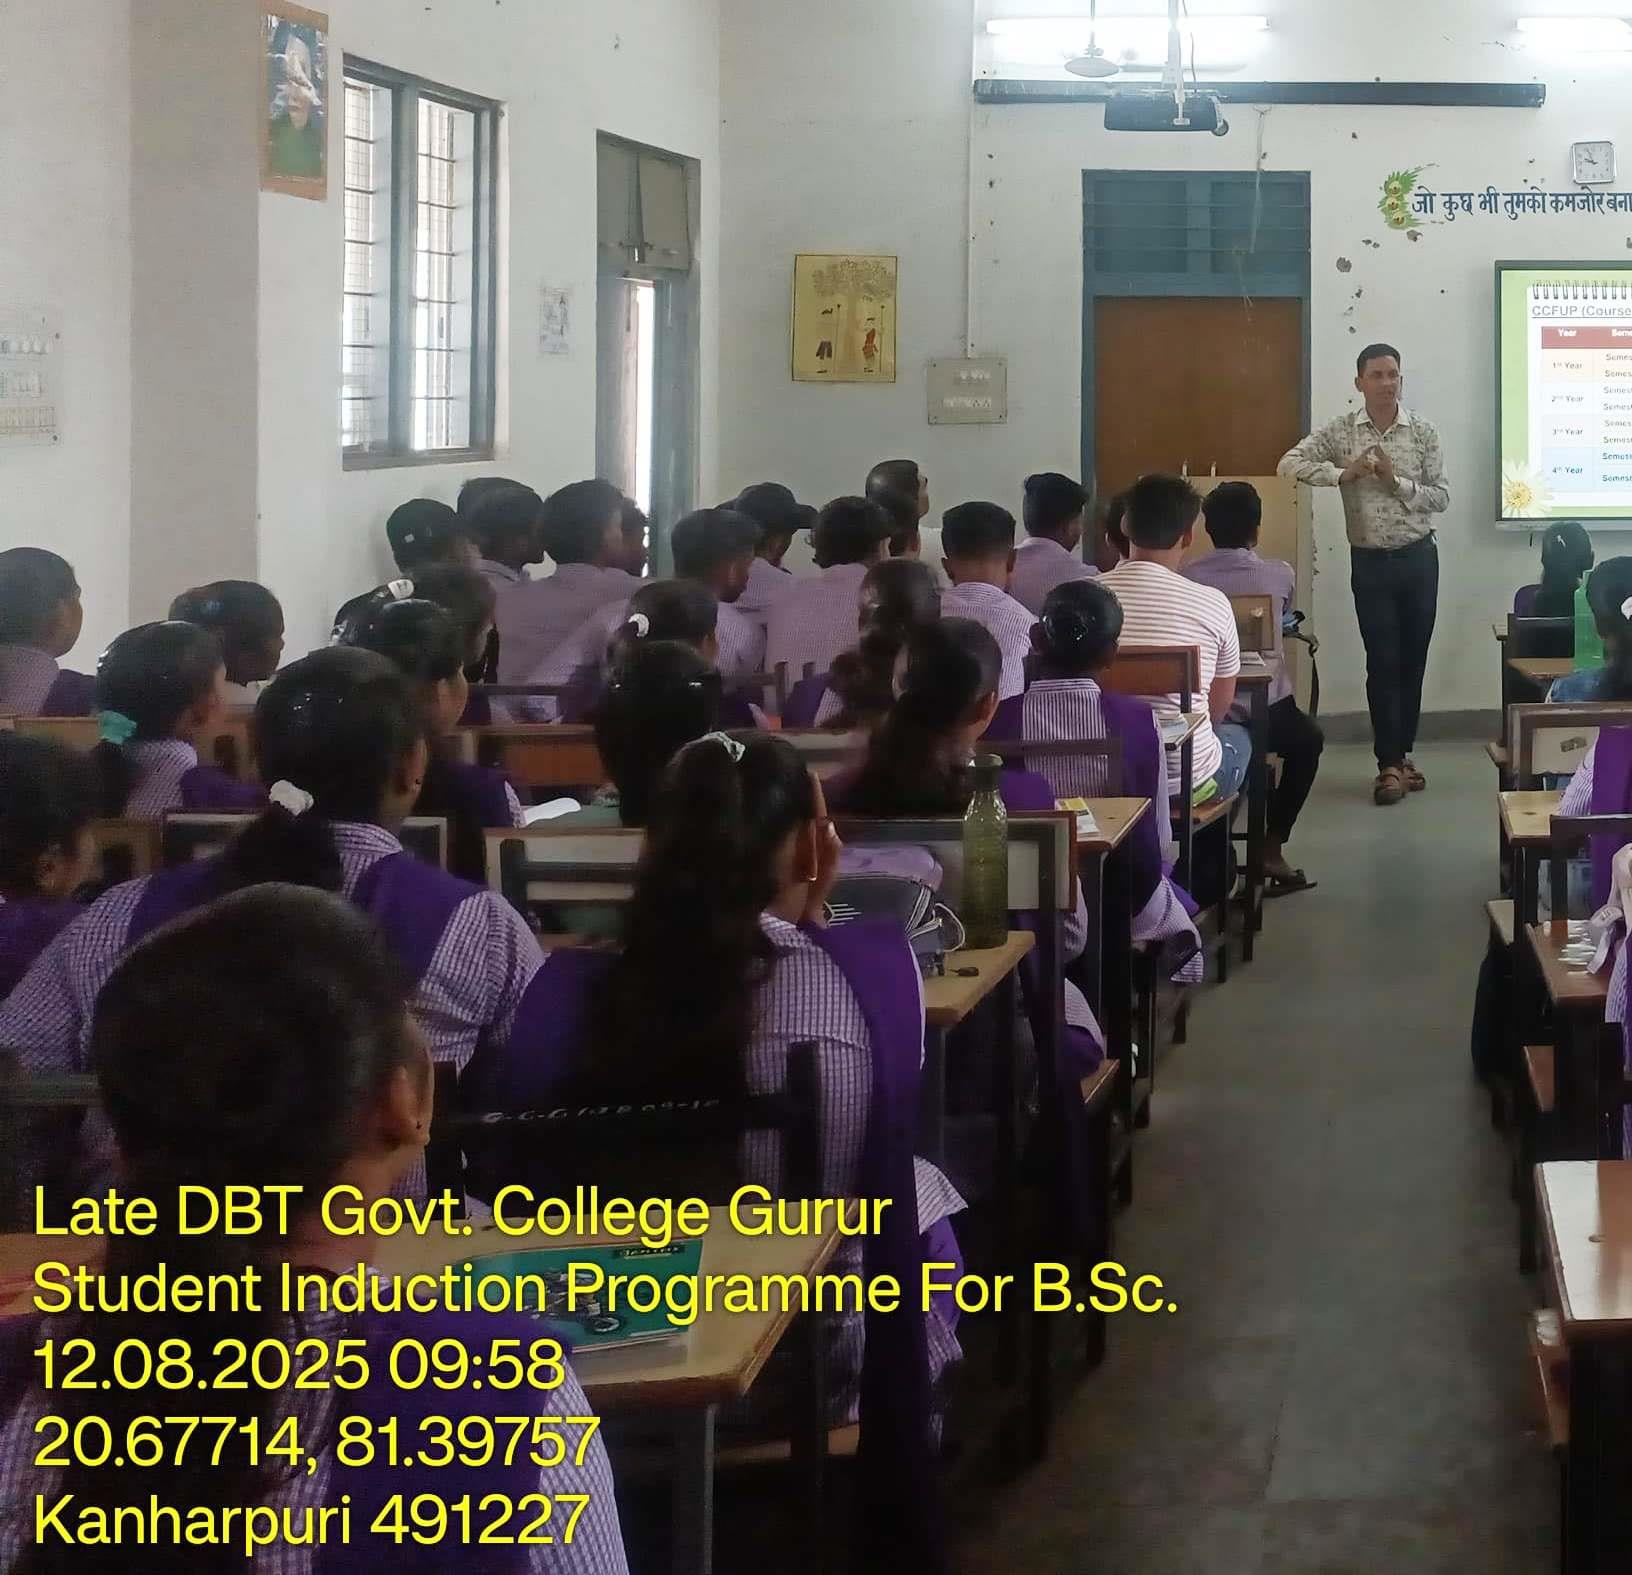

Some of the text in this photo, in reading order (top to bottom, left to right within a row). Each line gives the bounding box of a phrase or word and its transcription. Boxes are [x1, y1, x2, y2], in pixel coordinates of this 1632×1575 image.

[1412, 186, 1437, 214] जो
[1478, 185, 1500, 214] भी
[1503, 186, 1547, 220] तुमको
[1550, 186, 1605, 215] कमजोर
[1532, 306, 1578, 316] CCFUP
[1582, 305, 1632, 317] (Course
[1558, 329, 1577, 337] Year
